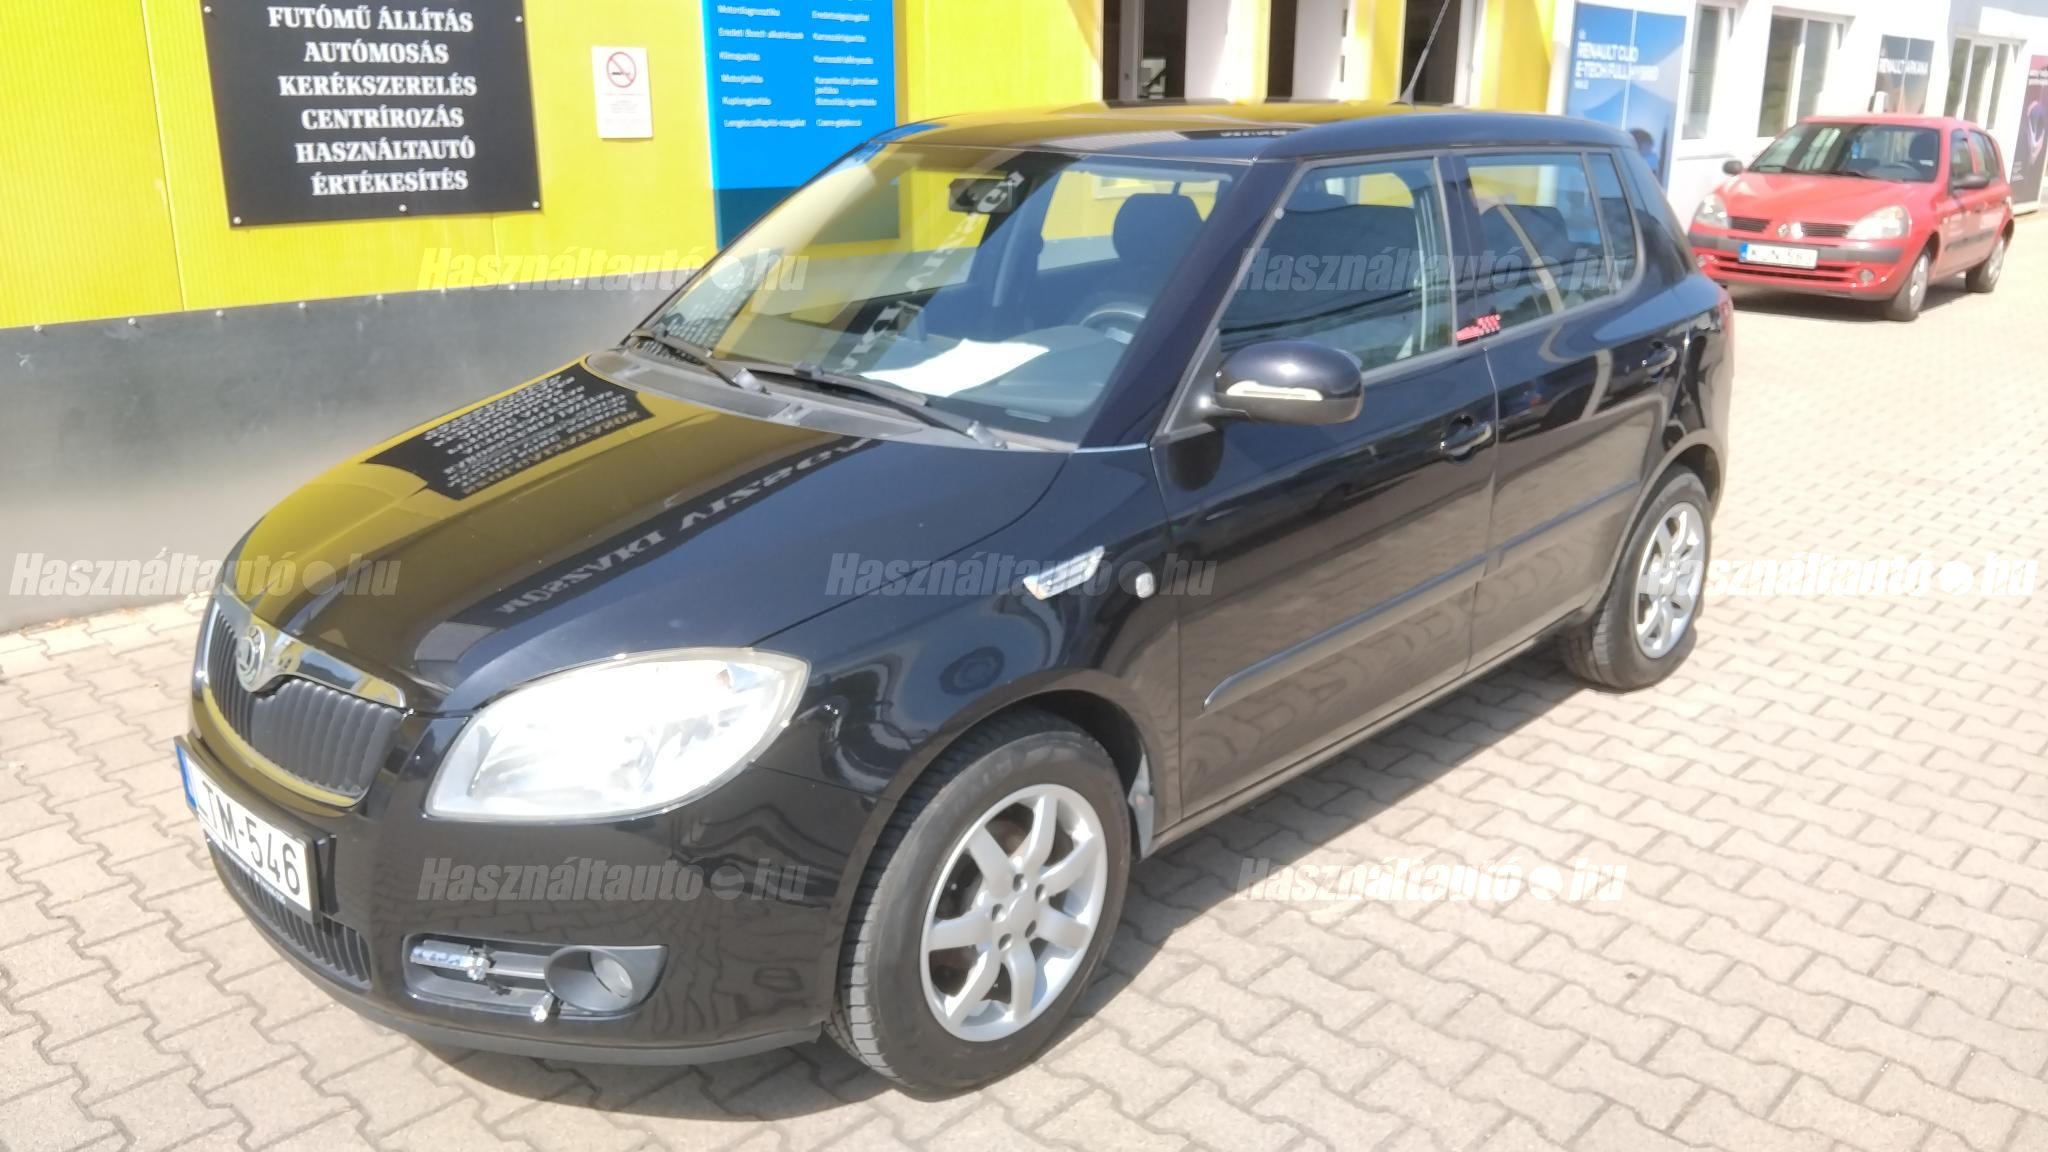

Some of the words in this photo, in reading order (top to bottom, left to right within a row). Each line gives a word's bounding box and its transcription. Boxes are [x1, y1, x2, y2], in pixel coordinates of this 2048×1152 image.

[267, 4, 371, 30] FUTÓMŰ
[377, 6, 474, 32] ÁLLÍTÁS
[303, 38, 450, 64] AUTÓMOSÁS
[278, 72, 478, 97] KERÉKSZERELÉS
[301, 104, 465, 130] CENTRÍROZÁS
[294, 135, 476, 163] HASZNÁLTAUTÓ
[311, 167, 469, 196] ÉRTÉKESÍTÉS
